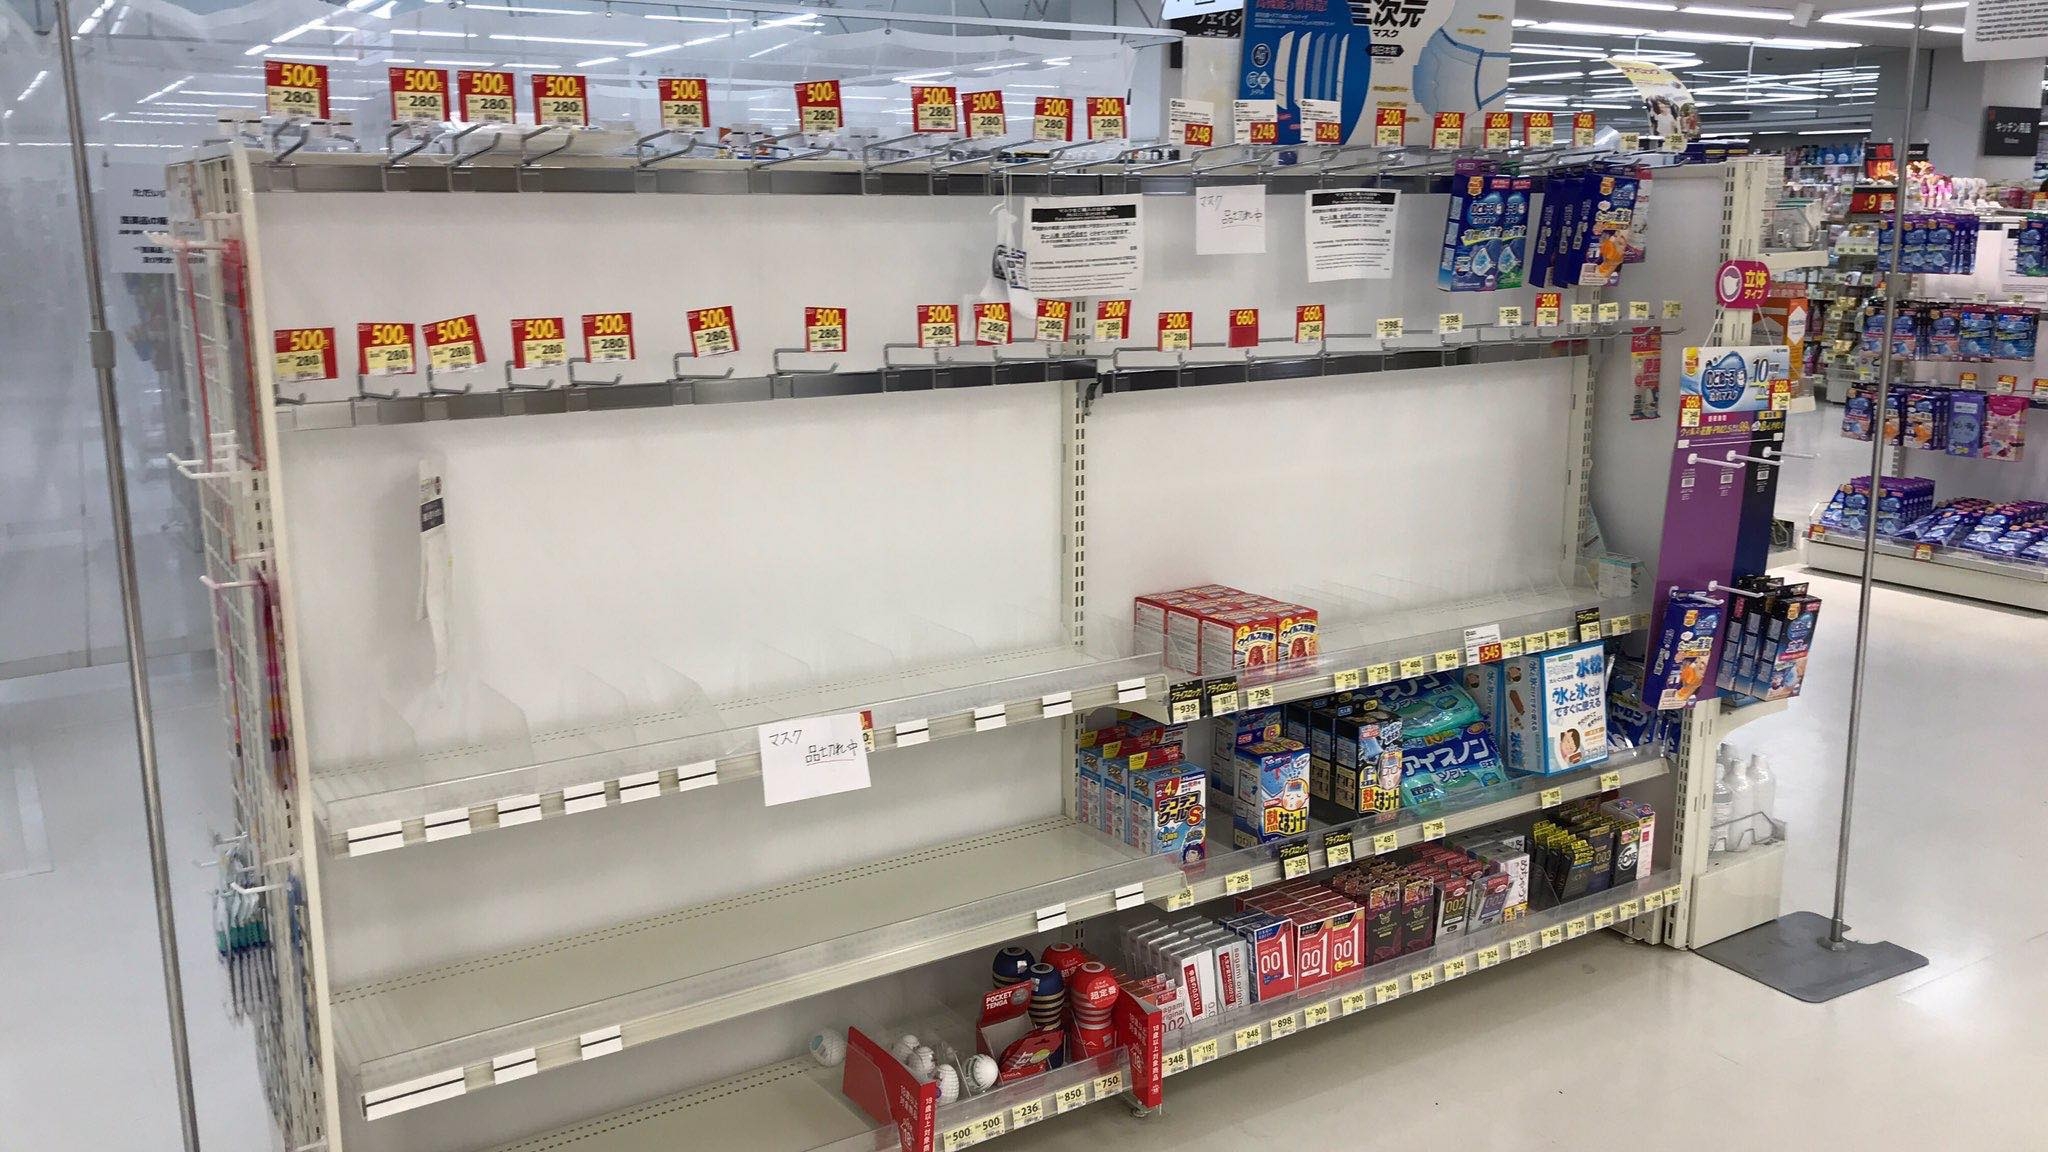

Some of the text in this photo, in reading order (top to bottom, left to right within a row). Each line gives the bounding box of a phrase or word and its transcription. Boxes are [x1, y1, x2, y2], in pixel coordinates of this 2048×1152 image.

[281, 64, 317, 87] 500
[404, 70, 441, 91] 500
[471, 73, 505, 94] 500
[546, 76, 577, 97] 500
[671, 80, 700, 100] 500
[282, 90, 313, 104] 280
[806, 82, 834, 102] 500
[923, 87, 951, 105] 500
[409, 95, 438, 107] 280
[480, 98, 508, 110] 280
[552, 101, 579, 113] 280
[972, 92, 998, 111] 500
[1043, 99, 1067, 117] 500
[1096, 98, 1119, 116] 500
[673, 103, 698, 115] 280
[813, 108, 834, 120] 280
[928, 106, 951, 117] 280
[980, 116, 1002, 127] 280
[1044, 119, 1065, 130] 280
[1101, 118, 1120, 129] 280
[1382, 110, 1400, 125] 500
[1440, 113, 1460, 128] 500
[928, 306, 952, 325] 500
[983, 303, 1007, 321] 500
[1044, 301, 1067, 319] 500
[1105, 302, 1125, 318] 500
[1303, 305, 1321, 321] 660
[594, 314, 624, 335] 500
[698, 309, 727, 329] 500
[815, 308, 839, 327] 500
[1166, 313, 1186, 329] 500
[1236, 309, 1255, 326] 660
[1446, 315, 1460, 324] 398
[436, 319, 469, 343] 500
[524, 319, 555, 339] 500
[703, 325, 727, 339] 280
[931, 326, 952, 338] 280
[986, 322, 1006, 335] 280
[1045, 319, 1064, 331] 280
[1384, 321, 1399, 330] 398
[290, 330, 325, 351] 500
[371, 324, 404, 345] 500
[818, 328, 839, 340] 280
[541, 344, 563, 356] 280
[600, 338, 625, 350] 280
[385, 349, 409, 362] 280
[448, 346, 472, 360] 280
[296, 354, 320, 367] 280
[1254, 688, 1270, 699] 798
[1180, 703, 1196, 713] 939
[769, 729, 803, 747] マスク
[1403, 737, 1490, 777] アイスノン
[1437, 766, 1470, 783] ソフト
[1158, 792, 1200, 812] デコデコ
[1237, 874, 1249, 884] 268
[1446, 898, 1466, 914] 002
[1385, 983, 1398, 993] 900
[985, 991, 1013, 1005] POCKET
[985, 998, 1009, 1011] TENGA
[1351, 994, 1364, 1004] 900
[1161, 1000, 1185, 1014] agami
[1315, 1006, 1328, 1016] 900
[1277, 1017, 1293, 1029] 898
[1168, 1053, 1184, 1066] 348
[1101, 1076, 1119, 1089] 750
[1064, 1088, 1082, 1101] 850
[1020, 1103, 1039, 1116] 236
[982, 1116, 1000, 1131] 500
[952, 1127, 971, 1142] 500
